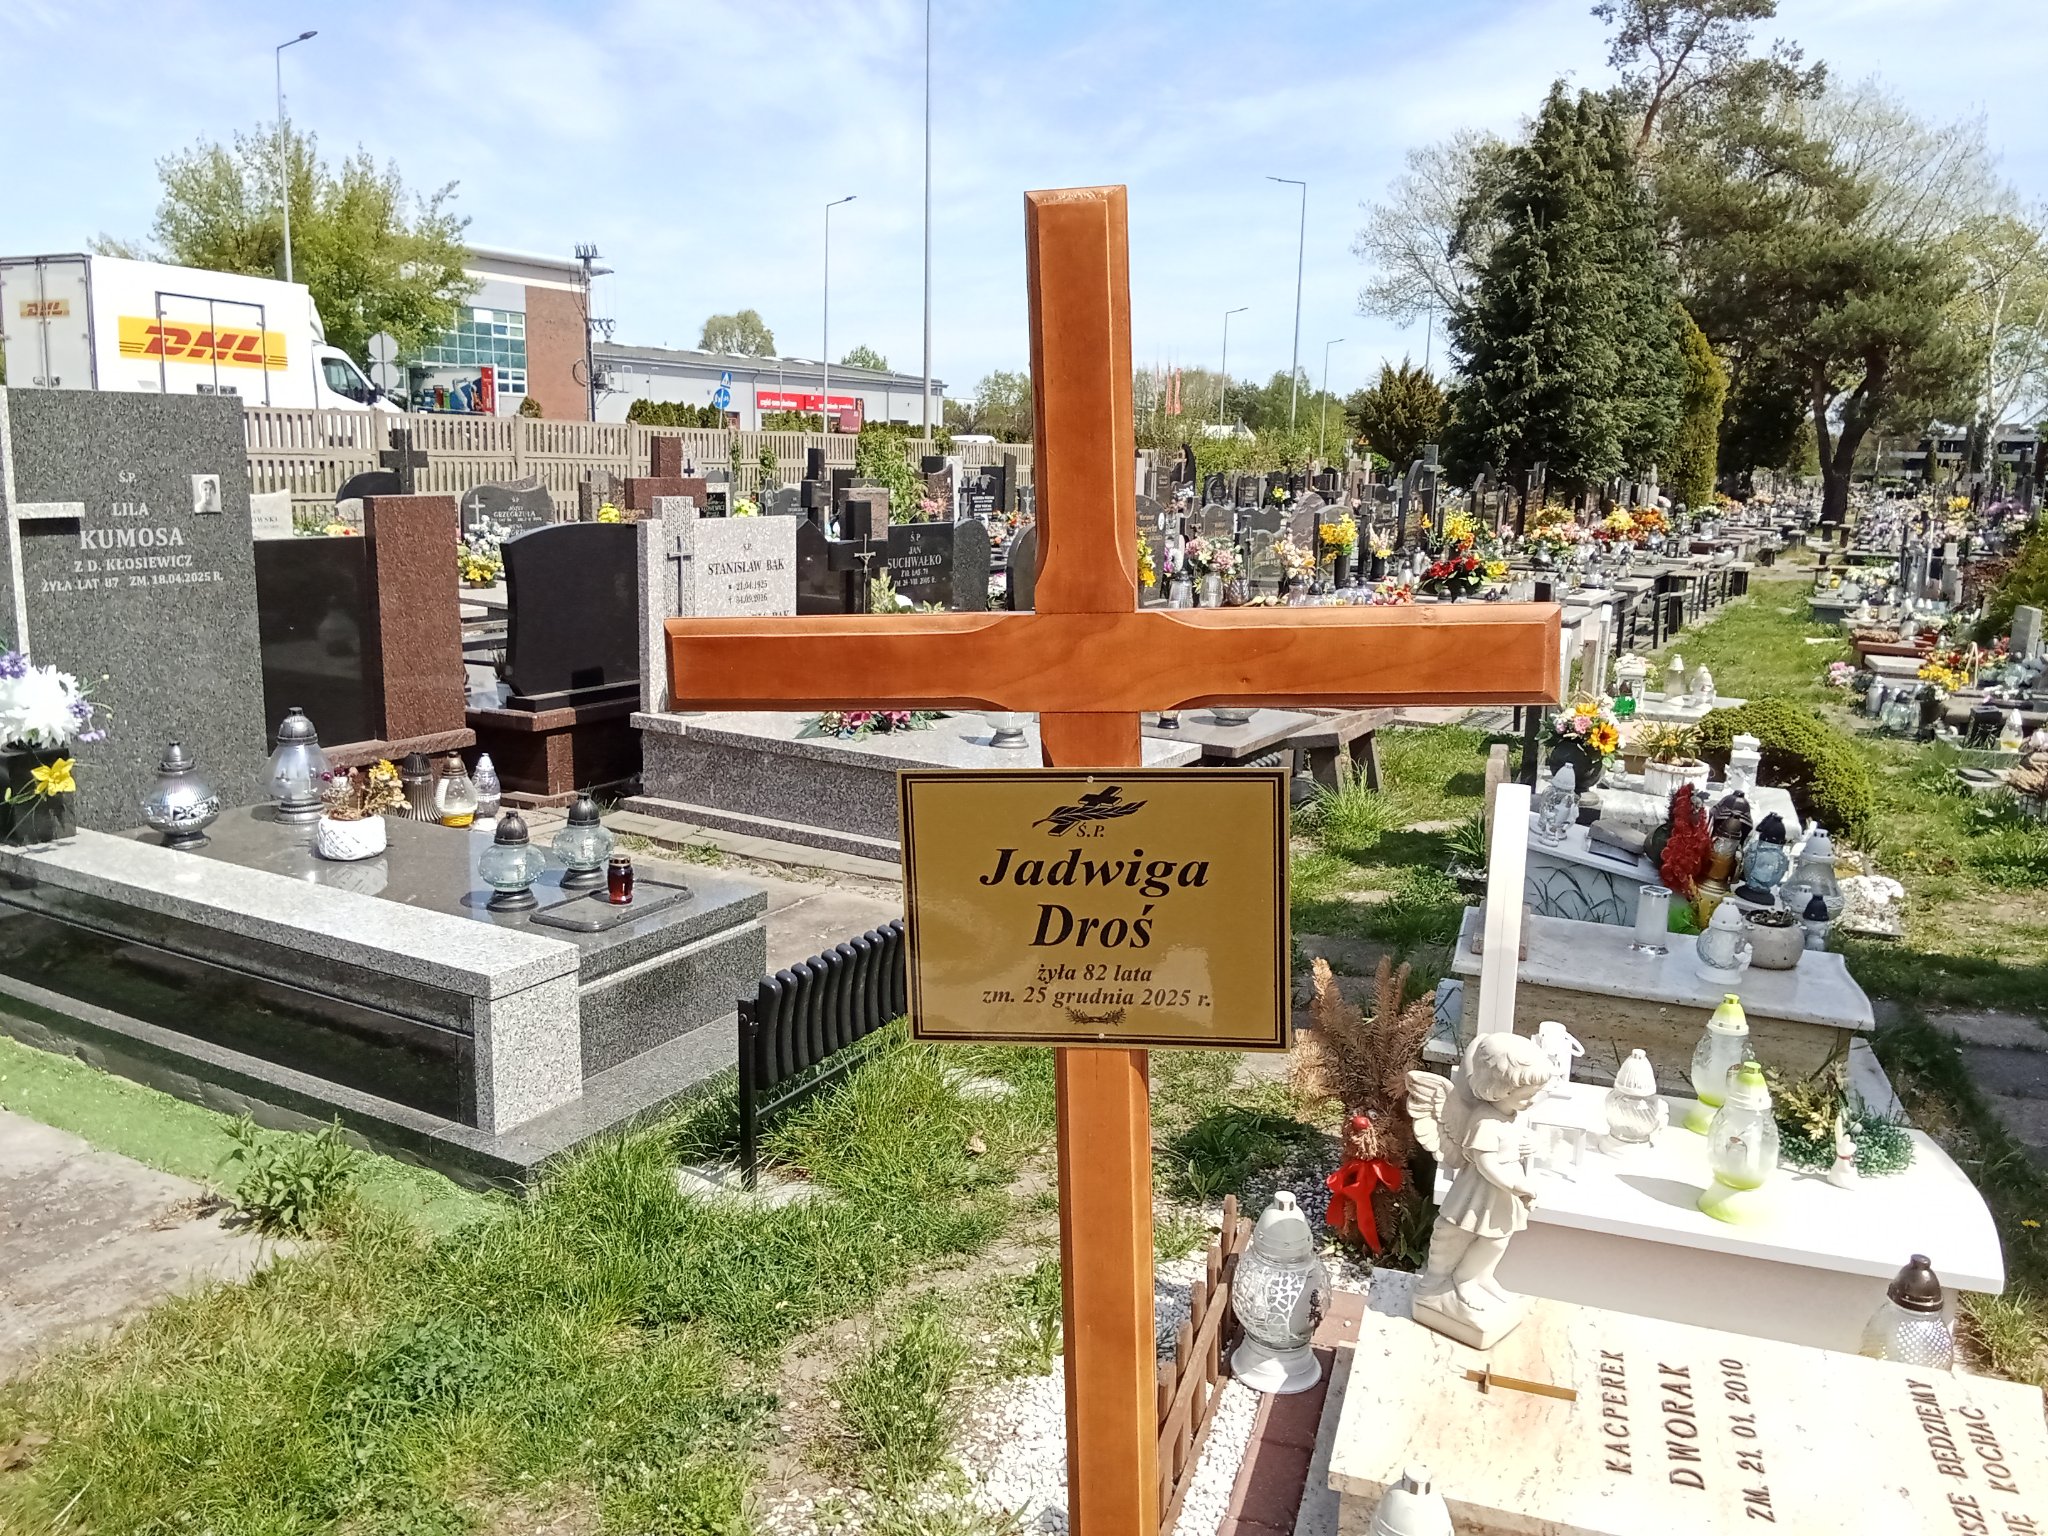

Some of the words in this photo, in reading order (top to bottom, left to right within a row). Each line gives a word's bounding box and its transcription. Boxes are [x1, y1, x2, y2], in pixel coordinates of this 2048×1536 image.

[27, 302, 63, 316] DHL
[143, 325, 263, 364] DHL
[111, 502, 149, 516] LILA
[80, 527, 184, 550] KUMOSA
[908, 546, 922, 555] JAN
[74, 560, 84, 573] Z
[88, 560, 101, 573] D.
[106, 554, 193, 571] KŁOSIEWICZ
[77, 578, 99, 590] LAT
[152, 572, 211, 585] 18.04.2025
[979, 848, 1209, 898] Jadwiga
[1028, 904, 1155, 948] Droś
[1037, 964, 1076, 984] żyła
[1084, 964, 1106, 981] 82
[1114, 964, 1152, 982] lata
[982, 989, 1015, 1004] zm.
[1023, 986, 1047, 1003] 25
[1052, 987, 1134, 1008] grudnia
[1140, 989, 1191, 1006] 2025
[1197, 993, 1211, 1007] r.
[1719, 1358, 1751, 1404] 2010
[1600, 1350, 1633, 1475] KACPEREK
[1657, 1362, 1706, 1490] DWORAK
[1905, 1378, 1969, 1479] BĘDZIEMY
[1950, 1405, 2020, 1495] KOCHAĆ
[1742, 1485, 1776, 1523] ZM.
